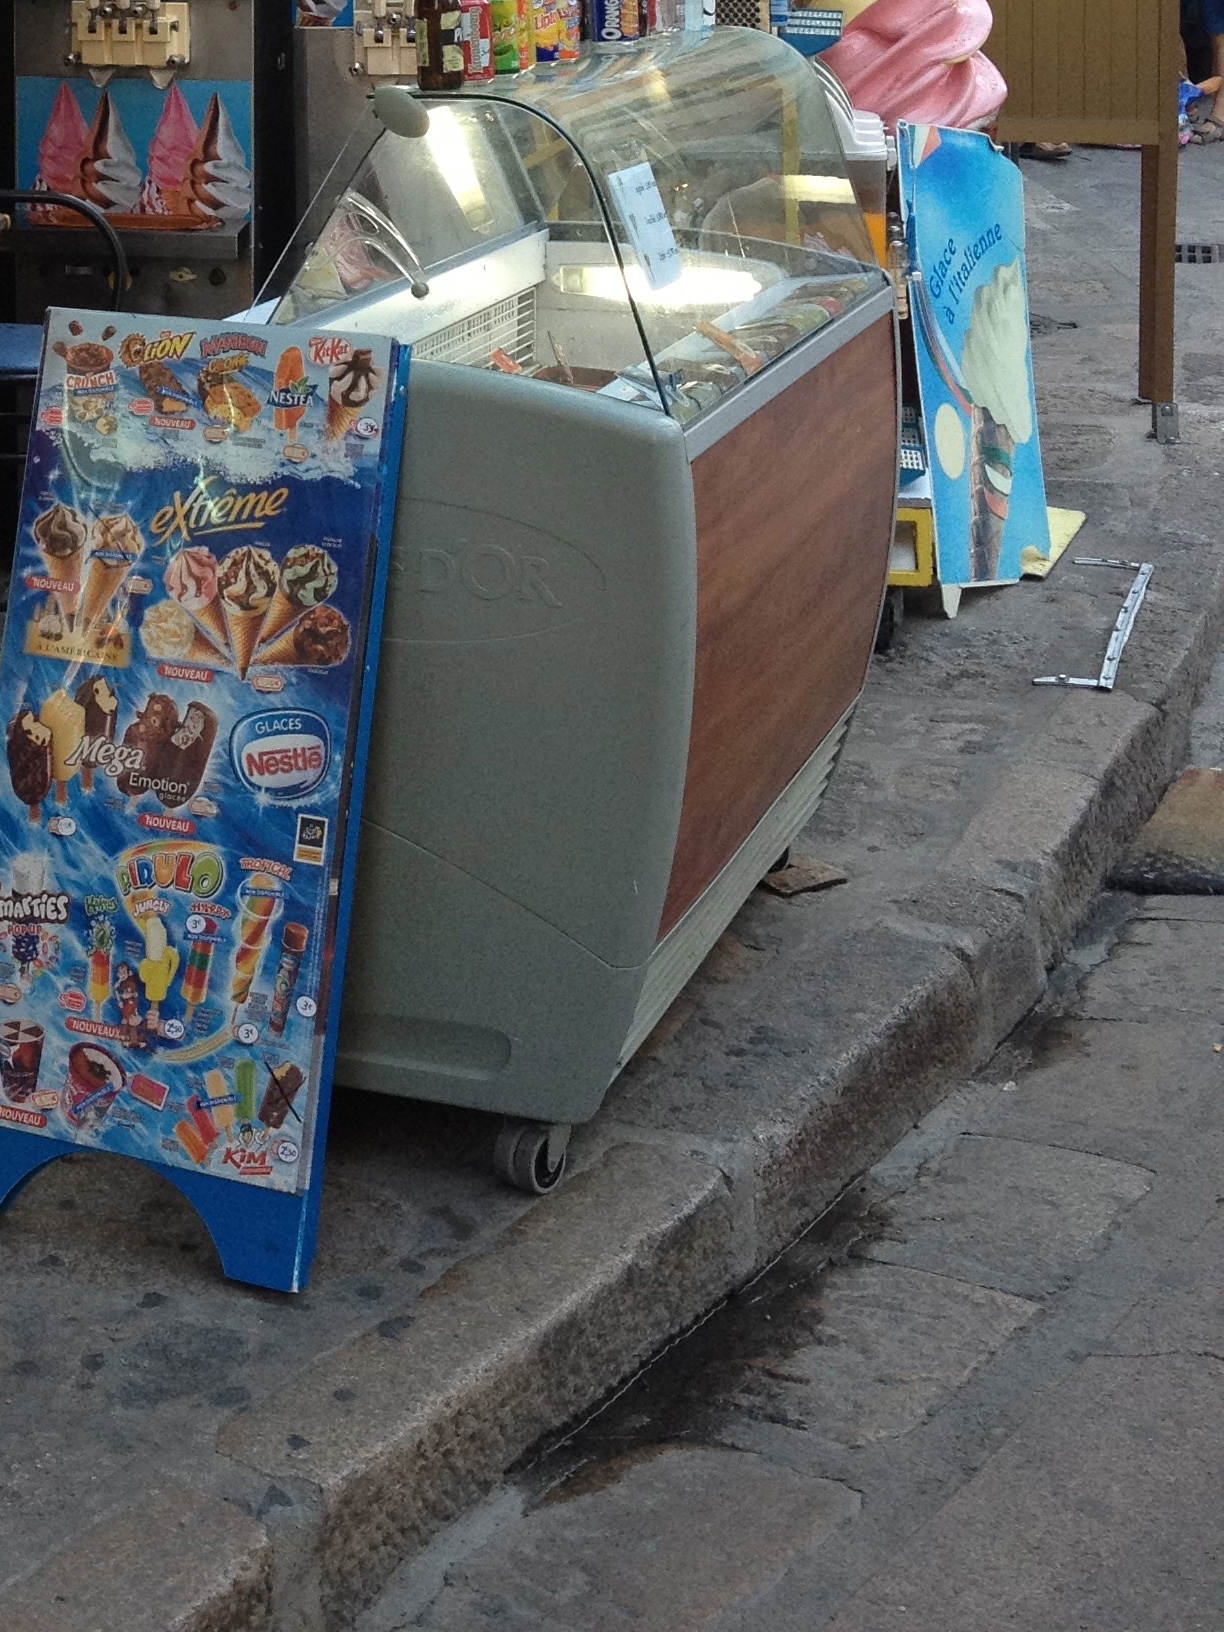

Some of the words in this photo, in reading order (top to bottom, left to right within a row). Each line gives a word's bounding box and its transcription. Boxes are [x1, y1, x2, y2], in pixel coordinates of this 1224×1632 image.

[930, 237, 957, 300] Glace
[947, 221, 1004, 306] l'italienne
[942, 304, 956, 325] à
[65, 372, 115, 389] CRUNCH
[268, 391, 314, 407] NESTEA
[31, 576, 76, 592] NOUVEAU
[164, 667, 209, 682] NOUVEAU
[255, 718, 302, 735] GLACES
[65, 735, 147, 776] Mega
[244, 744, 323, 778] Nestlé
[128, 772, 190, 796] Emotion
[145, 814, 190, 833] NOUVEAU
[116, 851, 223, 899] PIRULO
[239, 857, 293, 882] TROPICAL
